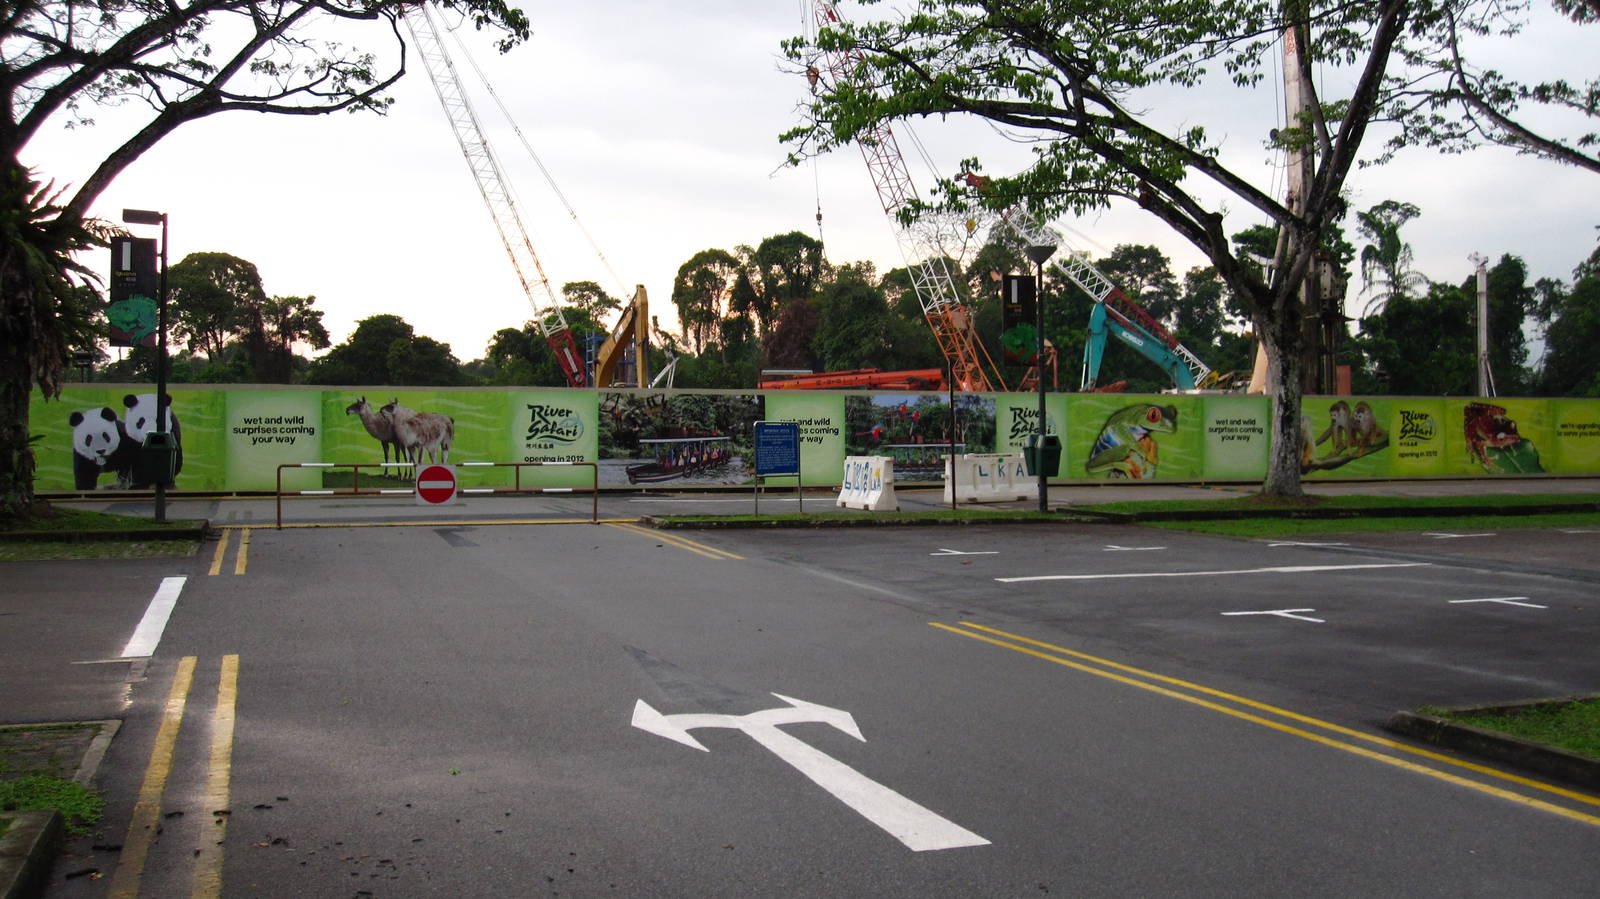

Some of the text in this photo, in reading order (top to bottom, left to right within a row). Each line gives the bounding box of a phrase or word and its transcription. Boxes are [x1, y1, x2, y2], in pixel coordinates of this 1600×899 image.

[527, 403, 573, 425] River
[1009, 406, 1040, 425] Rive
[1399, 410, 1430, 426] River
[243, 416, 304, 424] wet and wild
[233, 425, 315, 436] surprises coming
[526, 420, 578, 440] Safari
[810, 426, 839, 435] coming
[1009, 421, 1051, 439] Safai
[1208, 426, 1263, 434] surprises coming
[1399, 423, 1433, 440] Safari
[252, 436, 296, 445] your way
[807, 436, 824, 444] way
[1221, 434, 1250, 442] your way
